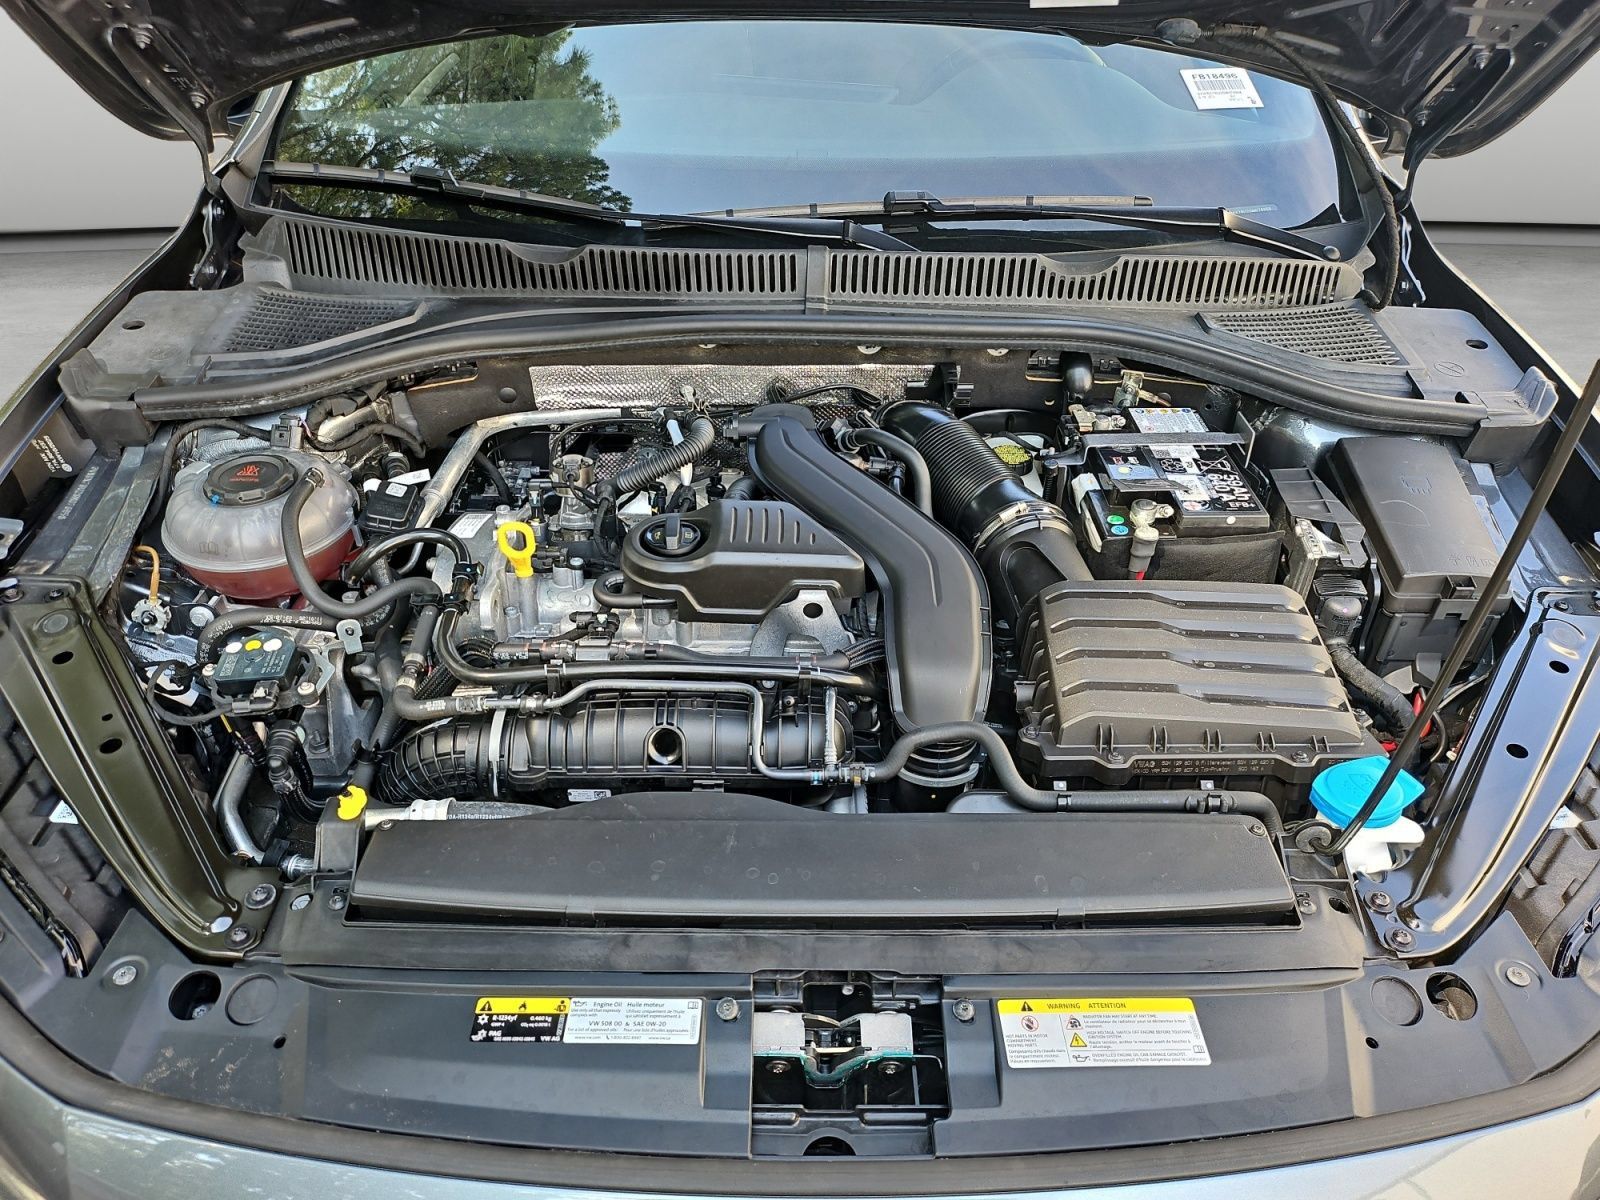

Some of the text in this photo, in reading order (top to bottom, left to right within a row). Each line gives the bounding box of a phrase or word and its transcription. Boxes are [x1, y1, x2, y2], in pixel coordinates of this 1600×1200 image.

[1191, 72, 1238, 80] FB18496
[1207, 473, 1231, 492] 640
[1223, 474, 1253, 501] 59Ah
